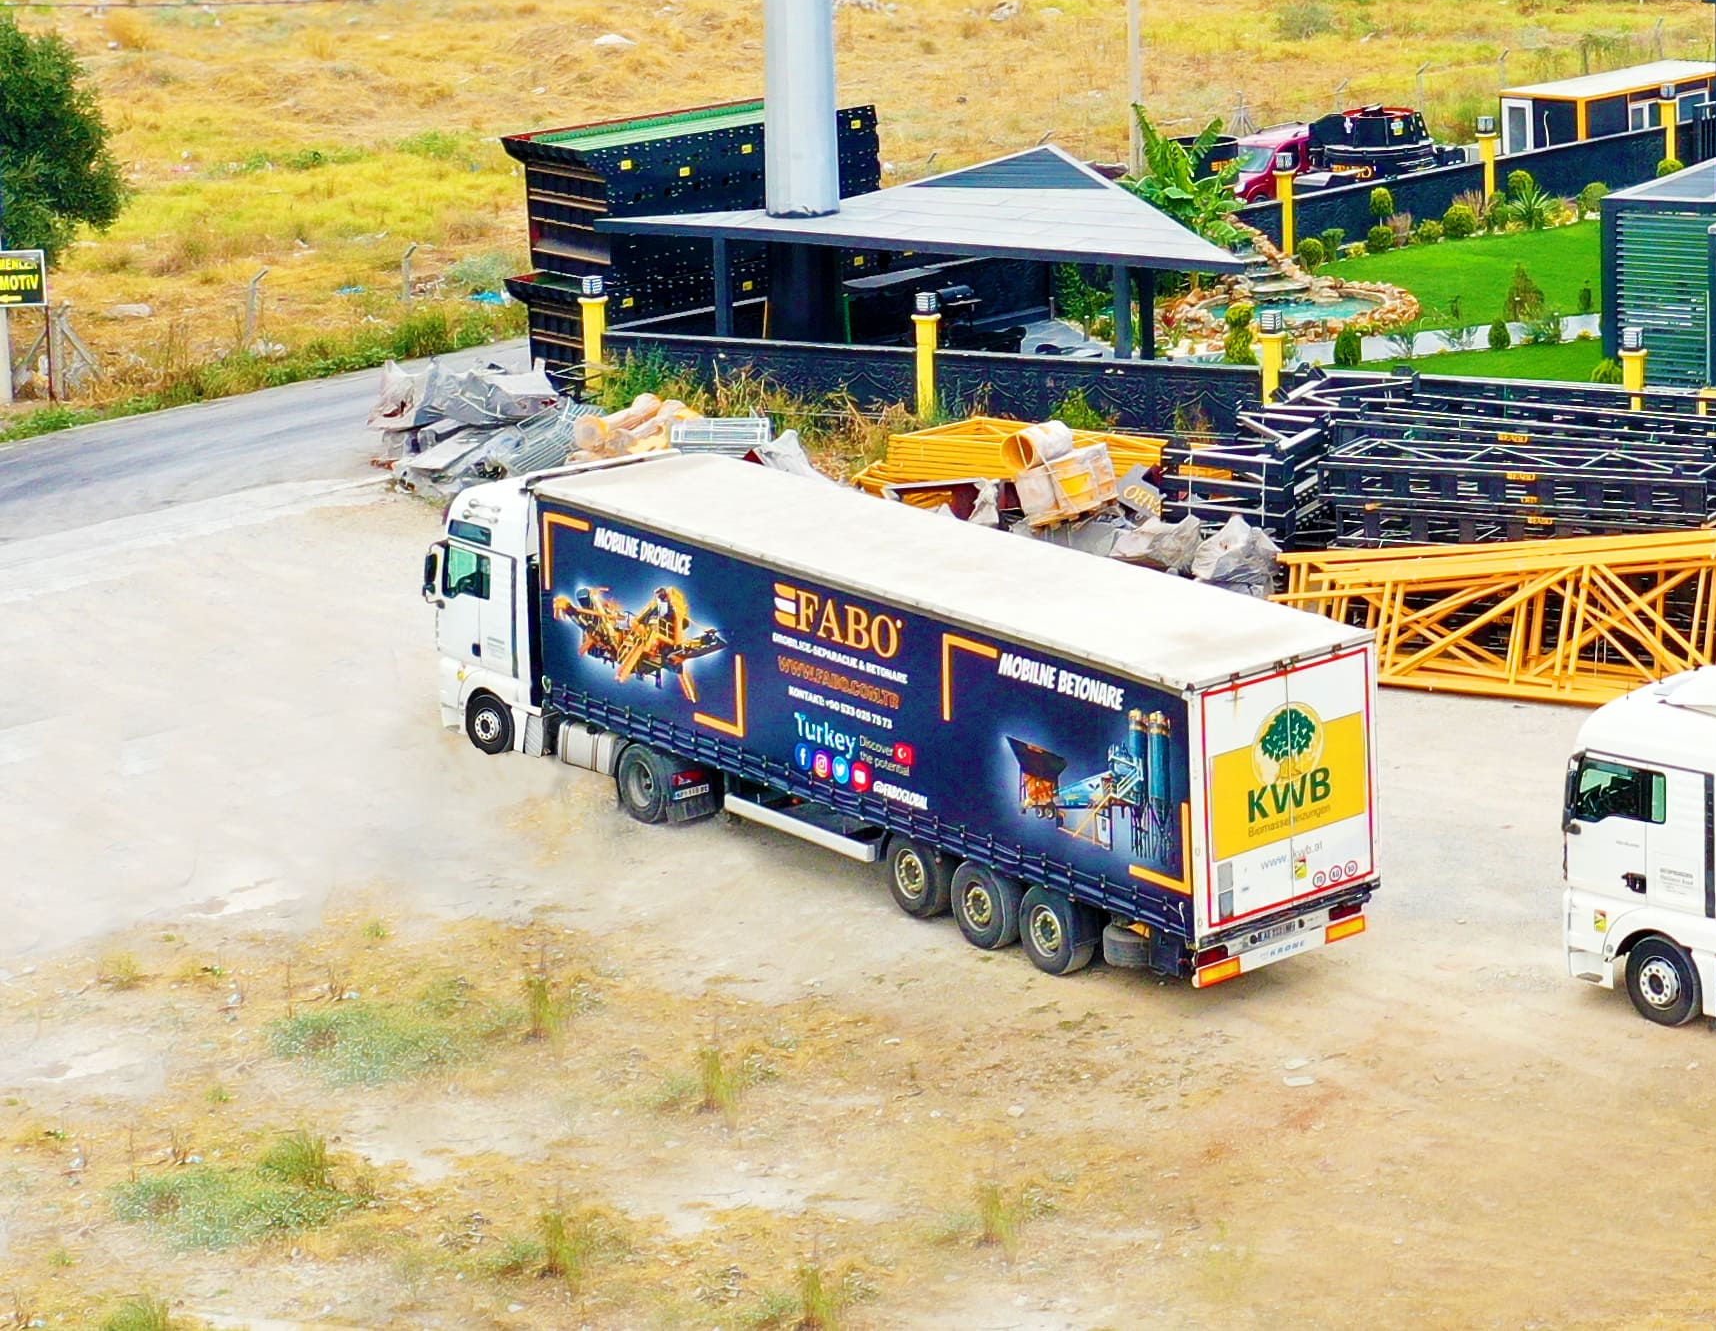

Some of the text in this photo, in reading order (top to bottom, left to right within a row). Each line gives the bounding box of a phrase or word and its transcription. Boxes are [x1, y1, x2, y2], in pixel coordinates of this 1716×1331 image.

[594, 527, 693, 576] MOBILNE DROBILICE
[795, 590, 899, 659] FABO
[998, 652, 1125, 711] MOBILNE BETONARE
[794, 711, 856, 759] Turkey
[859, 734, 894, 758] Discover
[860, 750, 874, 765] the
[1247, 767, 1332, 823] KWB
